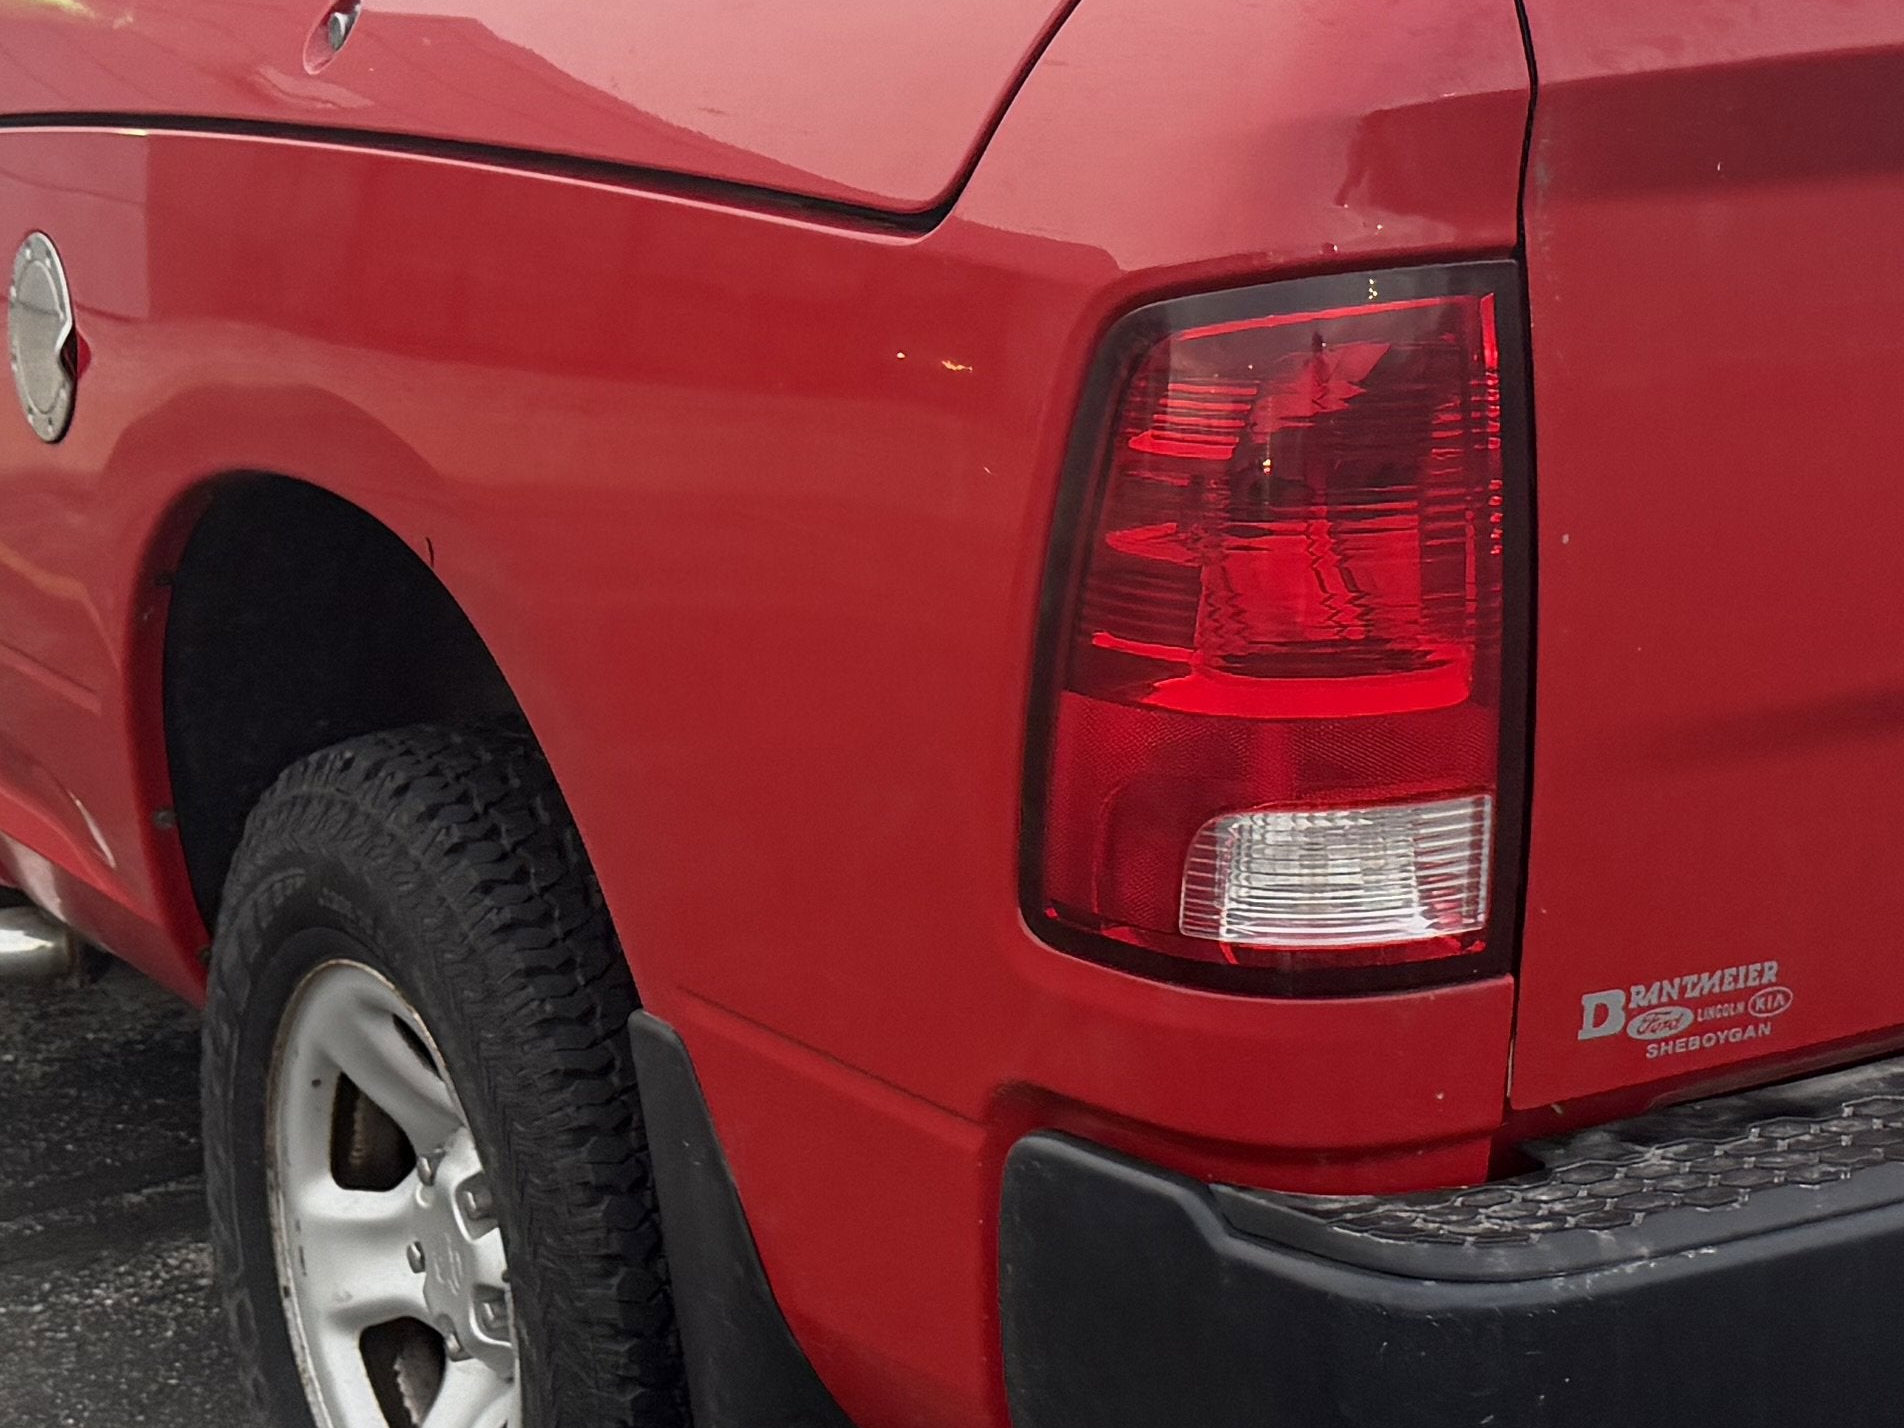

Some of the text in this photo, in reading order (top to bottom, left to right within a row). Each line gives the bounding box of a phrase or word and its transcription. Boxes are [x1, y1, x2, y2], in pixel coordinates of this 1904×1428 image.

[1635, 991, 1787, 1037] Ford LINCOLN KIA
[1645, 1021, 1772, 1059] SHEBOYGAN
